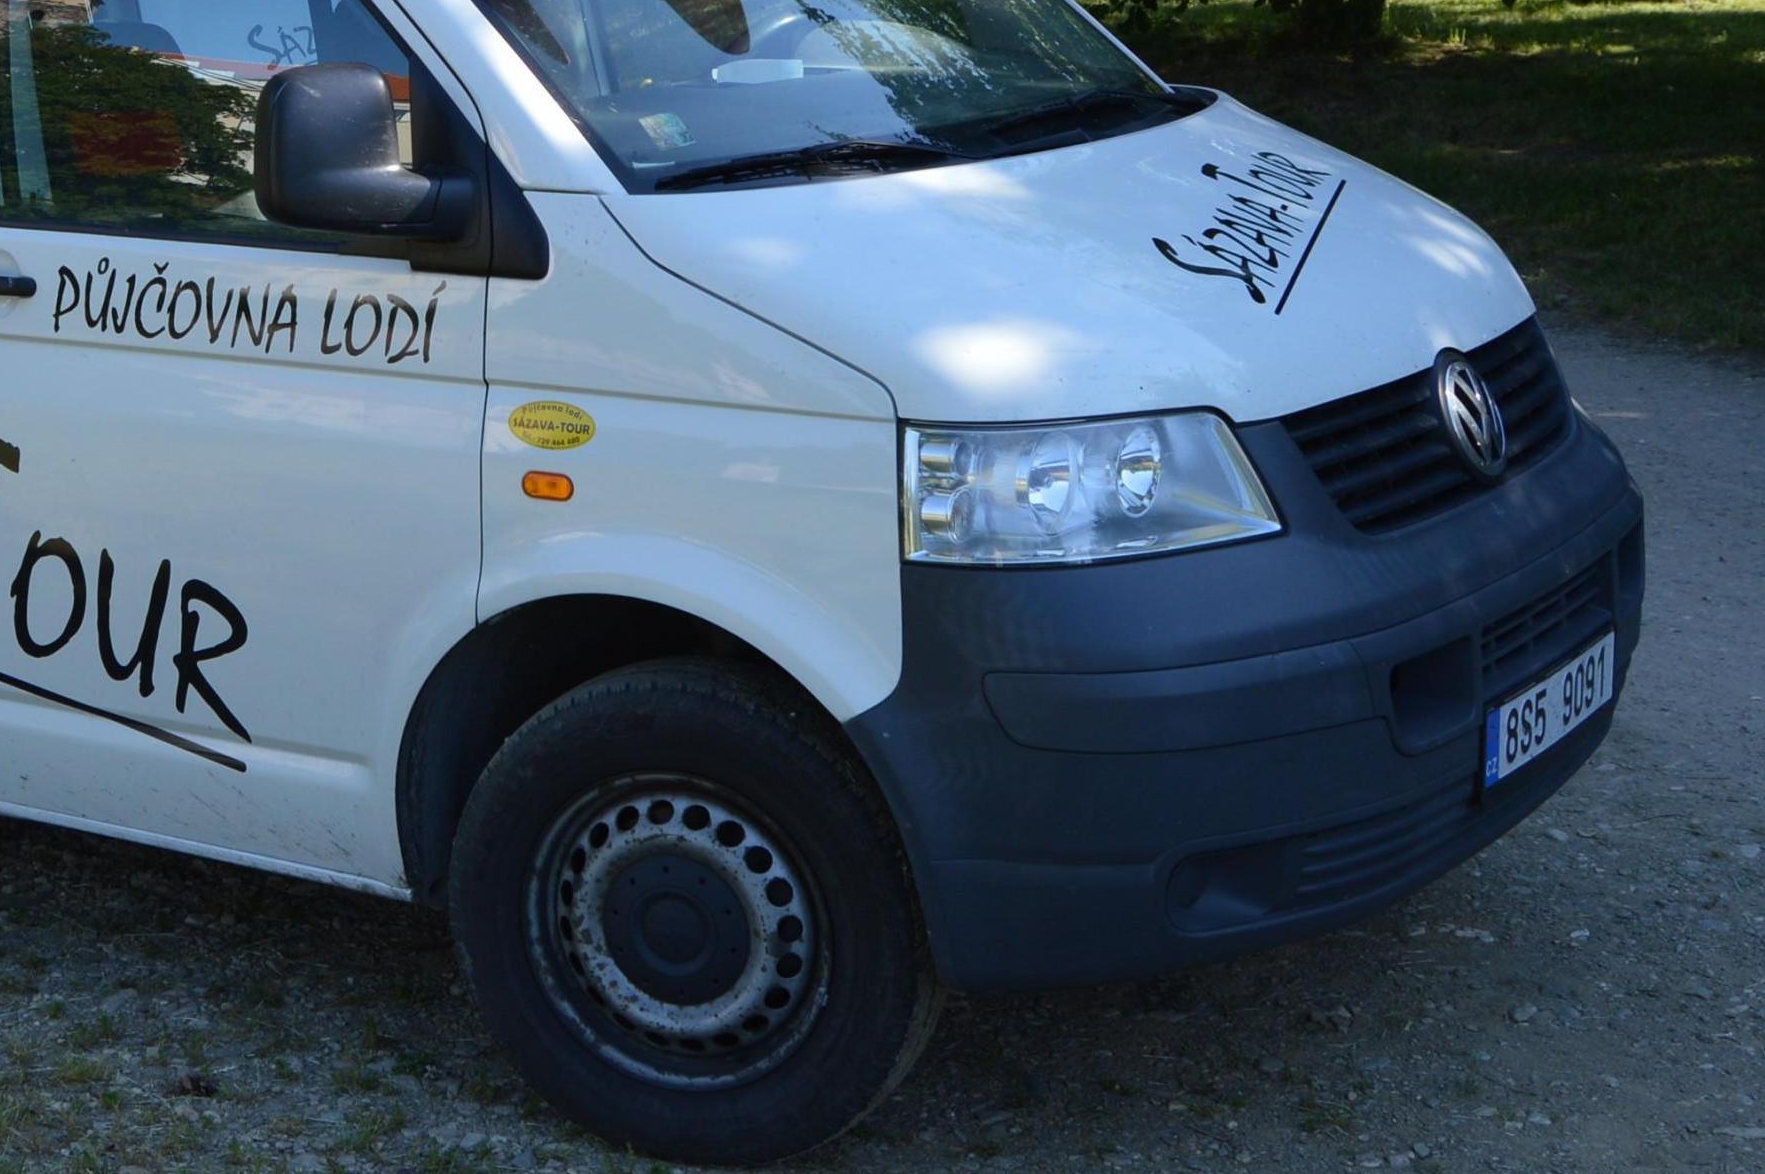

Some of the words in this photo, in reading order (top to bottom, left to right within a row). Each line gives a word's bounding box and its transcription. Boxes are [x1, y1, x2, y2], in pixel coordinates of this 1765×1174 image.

[1152, 152, 1332, 304] SÁZAVA-TOUR
[53, 257, 297, 354] PŮJČOVNA
[320, 279, 447, 364] LODÍ
[1505, 688, 1547, 764] 8S5
[1563, 646, 1605, 726] 9091
[1486, 757, 1498, 774] CZ
